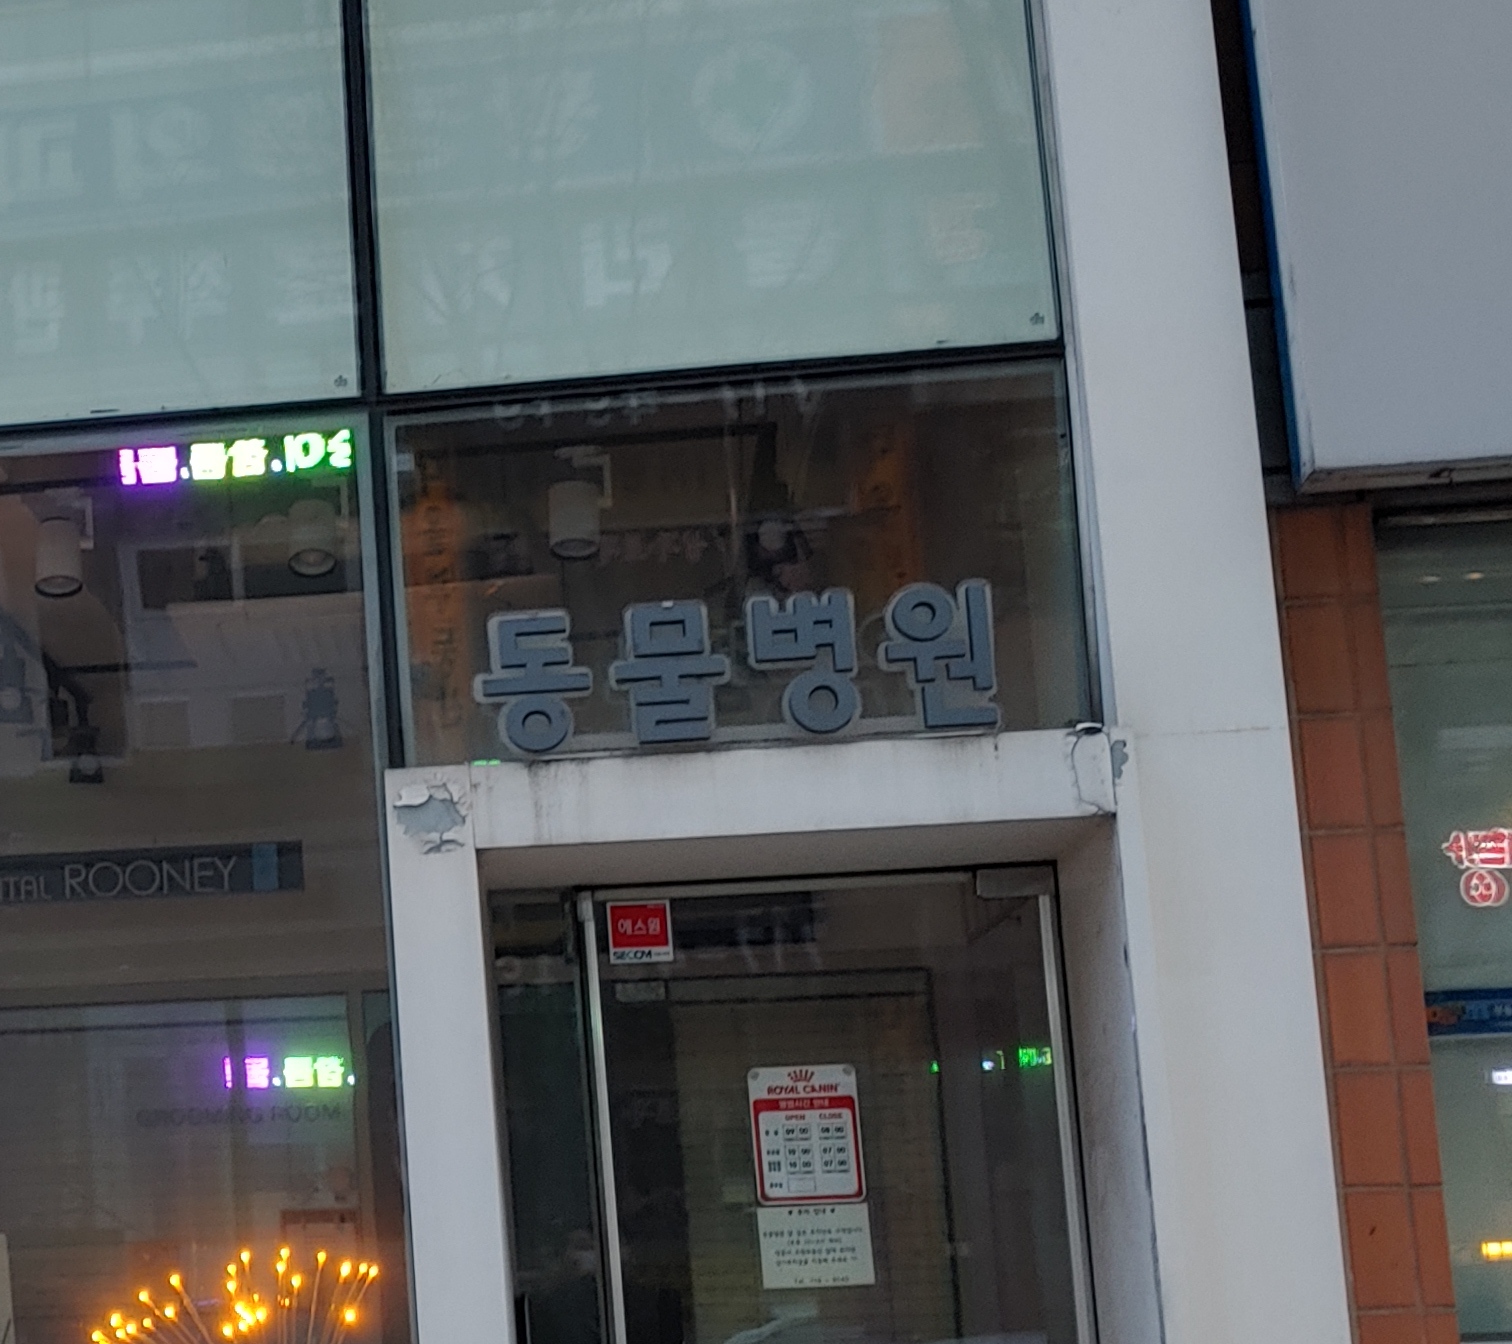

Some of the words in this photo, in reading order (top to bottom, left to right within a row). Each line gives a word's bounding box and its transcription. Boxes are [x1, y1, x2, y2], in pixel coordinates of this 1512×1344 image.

[473, 576, 1001, 755] 동물병원
[64, 856, 237, 900] ROONEY
[617, 916, 661, 936] 에스원
[766, 1084, 801, 1096] ROYAL
[803, 1083, 838, 1095] CANIN
